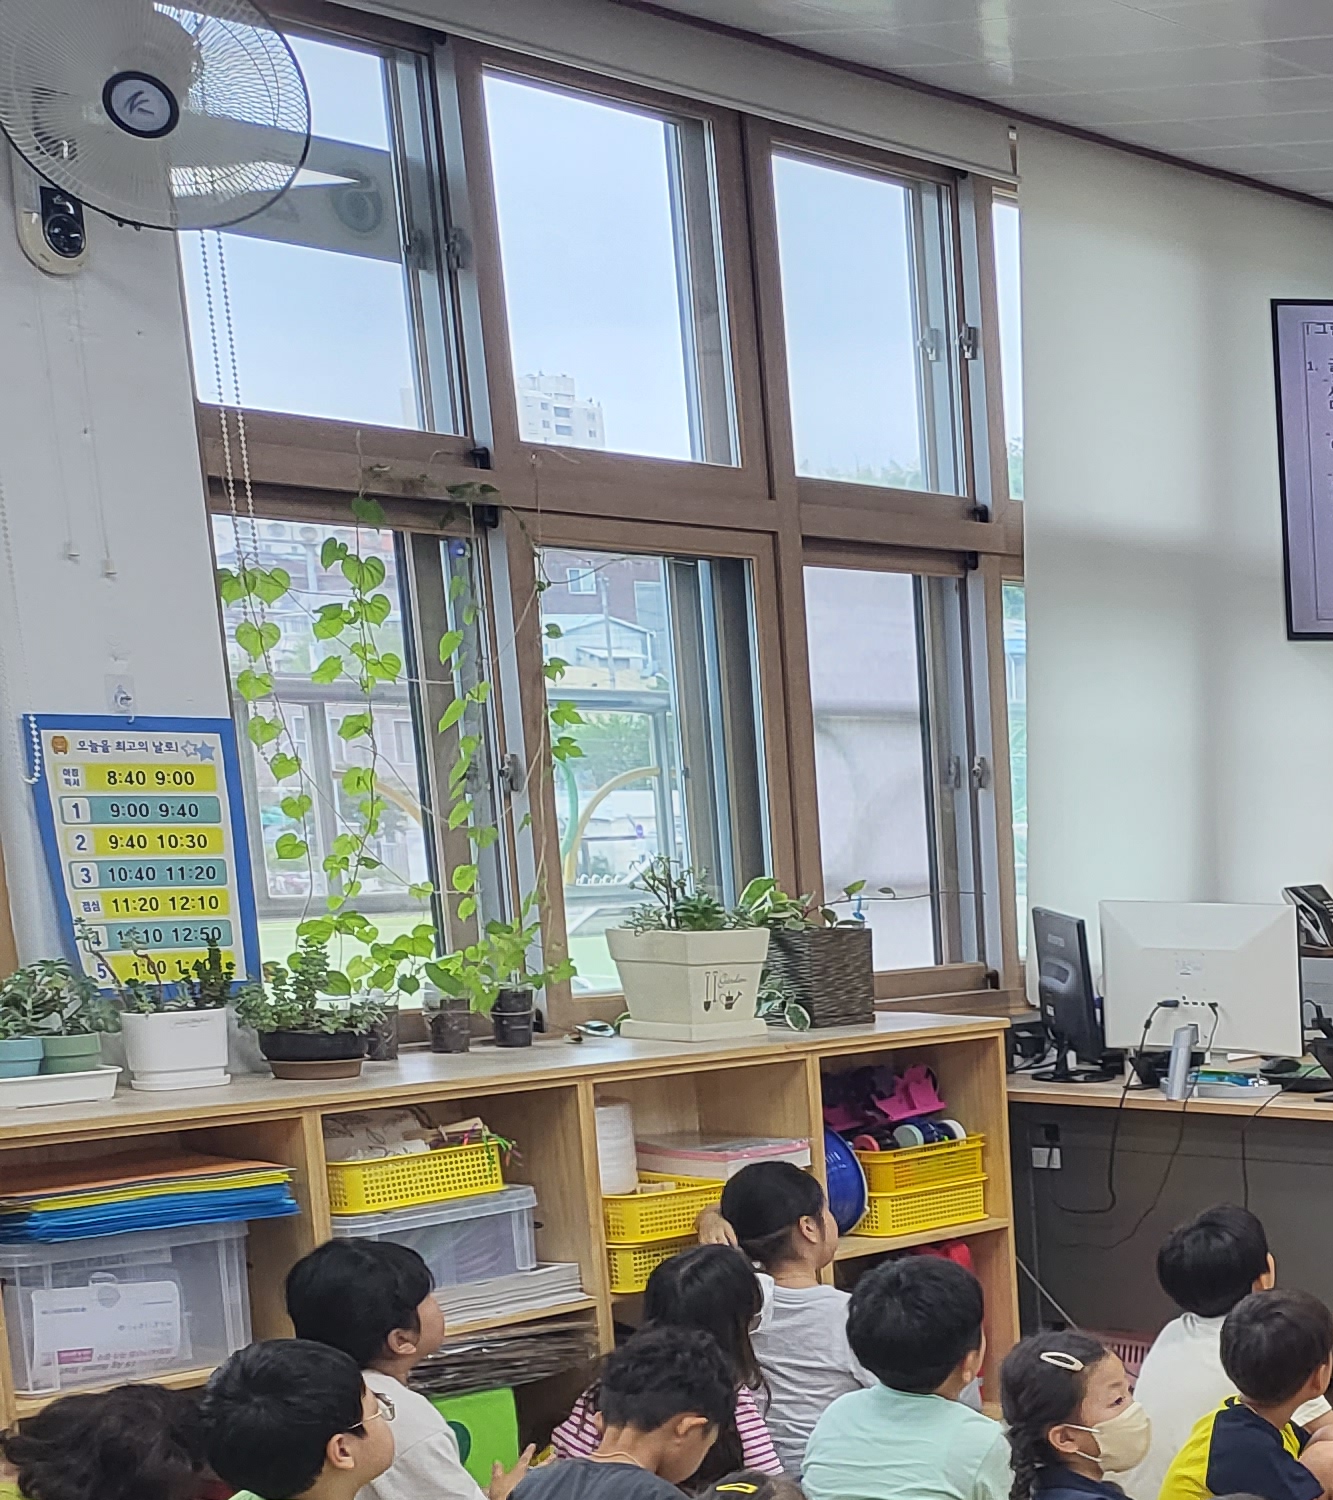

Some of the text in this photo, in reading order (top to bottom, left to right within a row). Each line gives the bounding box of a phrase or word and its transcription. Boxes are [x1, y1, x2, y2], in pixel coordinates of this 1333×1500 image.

[116, 741, 148, 752] 최고의
[107, 771, 194, 785] 8:40 9:00
[72, 803, 199, 818] 1 9:00 9:40
[75, 834, 207, 851] 2 9:40 10:30
[81, 866, 216, 884] 3 10:40 11:20
[82, 895, 219, 913] 점심 11:20 12:10
[172, 927, 221, 942] 12:50
[96, 963, 107, 979] 5
[132, 961, 166, 976] 1:00
